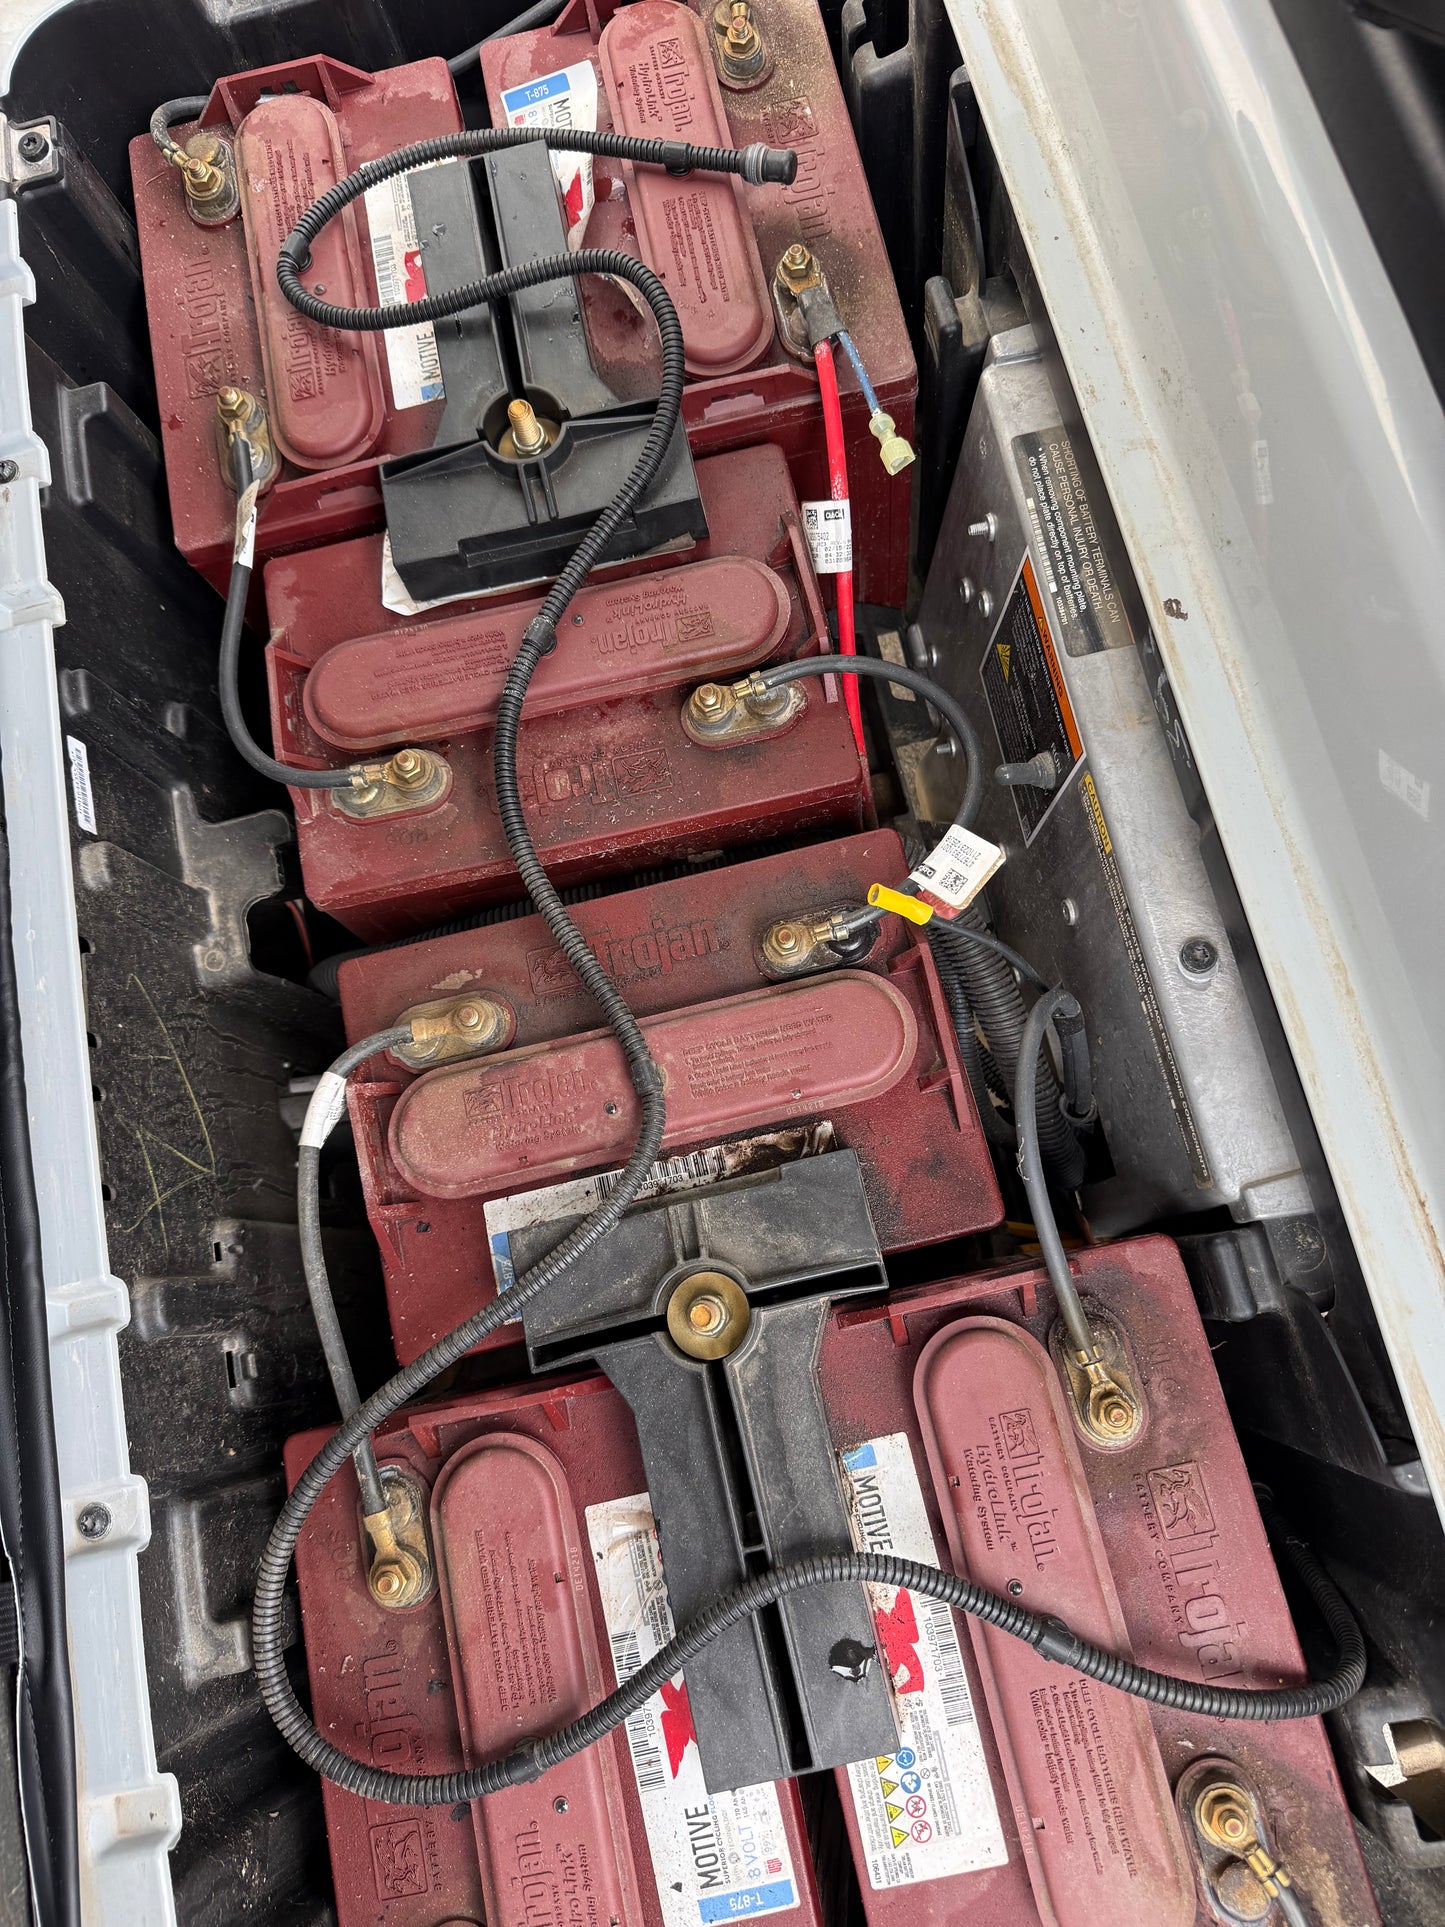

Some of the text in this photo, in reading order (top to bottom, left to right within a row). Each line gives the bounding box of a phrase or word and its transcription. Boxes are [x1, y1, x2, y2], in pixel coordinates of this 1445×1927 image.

[524, 84, 549, 101] T-875
[552, 97, 573, 132] MOT
[658, 63, 700, 128] Trojan
[173, 259, 230, 358] Trojan
[415, 333, 440, 380] MOTIVE
[1027, 456, 1080, 620] do not place plate directly on top of batteries.
[1036, 453, 1088, 612] When removing component mounting plate,
[1048, 443, 1103, 612] CAUSE PERSONAL INJURY OR DEATH.
[1060, 439, 1119, 623] SHORTING OF BATTERY TERMINALS CAN
[595, 619, 677, 658] Trojan
[612, 592, 686, 618] HydroLink
[1038, 628, 1065, 698] WARNING
[584, 909, 721, 985] Trojan
[1086, 781, 1109, 846] CAUTION
[1107, 856, 1127, 909] EXPOSURE
[1124, 910, 1131, 924] TO
[1128, 926, 1142, 961] WATER
[1139, 962, 1149, 984] MAY
[1146, 986, 1164, 1030] DAMAGE
[1160, 1032, 1184, 1098] ELECTRONIC
[1181, 1100, 1208, 1176] COMPONENTS
[502, 1062, 592, 1111] Trojan
[640, 1174, 683, 1190] 0391703
[963, 1448, 995, 1552] Watering System
[973, 1443, 1012, 1543] HydroLink
[988, 1416, 1018, 1513] BATTERY COMPANY
[852, 1474, 894, 1554] MOTIVE
[1006, 1455, 1067, 1566] Trojan
[1132, 1472, 1183, 1626] BATTERY COMPANY
[474, 1529, 509, 1711] DEEP CYCLE BATTERIES NEED WATER
[1156, 1533, 1259, 1701] Troja
[642, 1700, 655, 1736] 10397
[1027, 1689, 1076, 1845] White color = battery needs water
[1078, 1678, 1137, 1878] DEEP CYCLE BATTERIES NEED WATER
[507, 1828, 559, 1927] rojan
[684, 1803, 723, 1889] MOTIVE
[711, 1814, 730, 1883] SUPERIOR CYCLING
[737, 1823, 761, 1878] 8 VOLT
[870, 1859, 882, 1883] 106431
[728, 1891, 763, 1910] T-875
